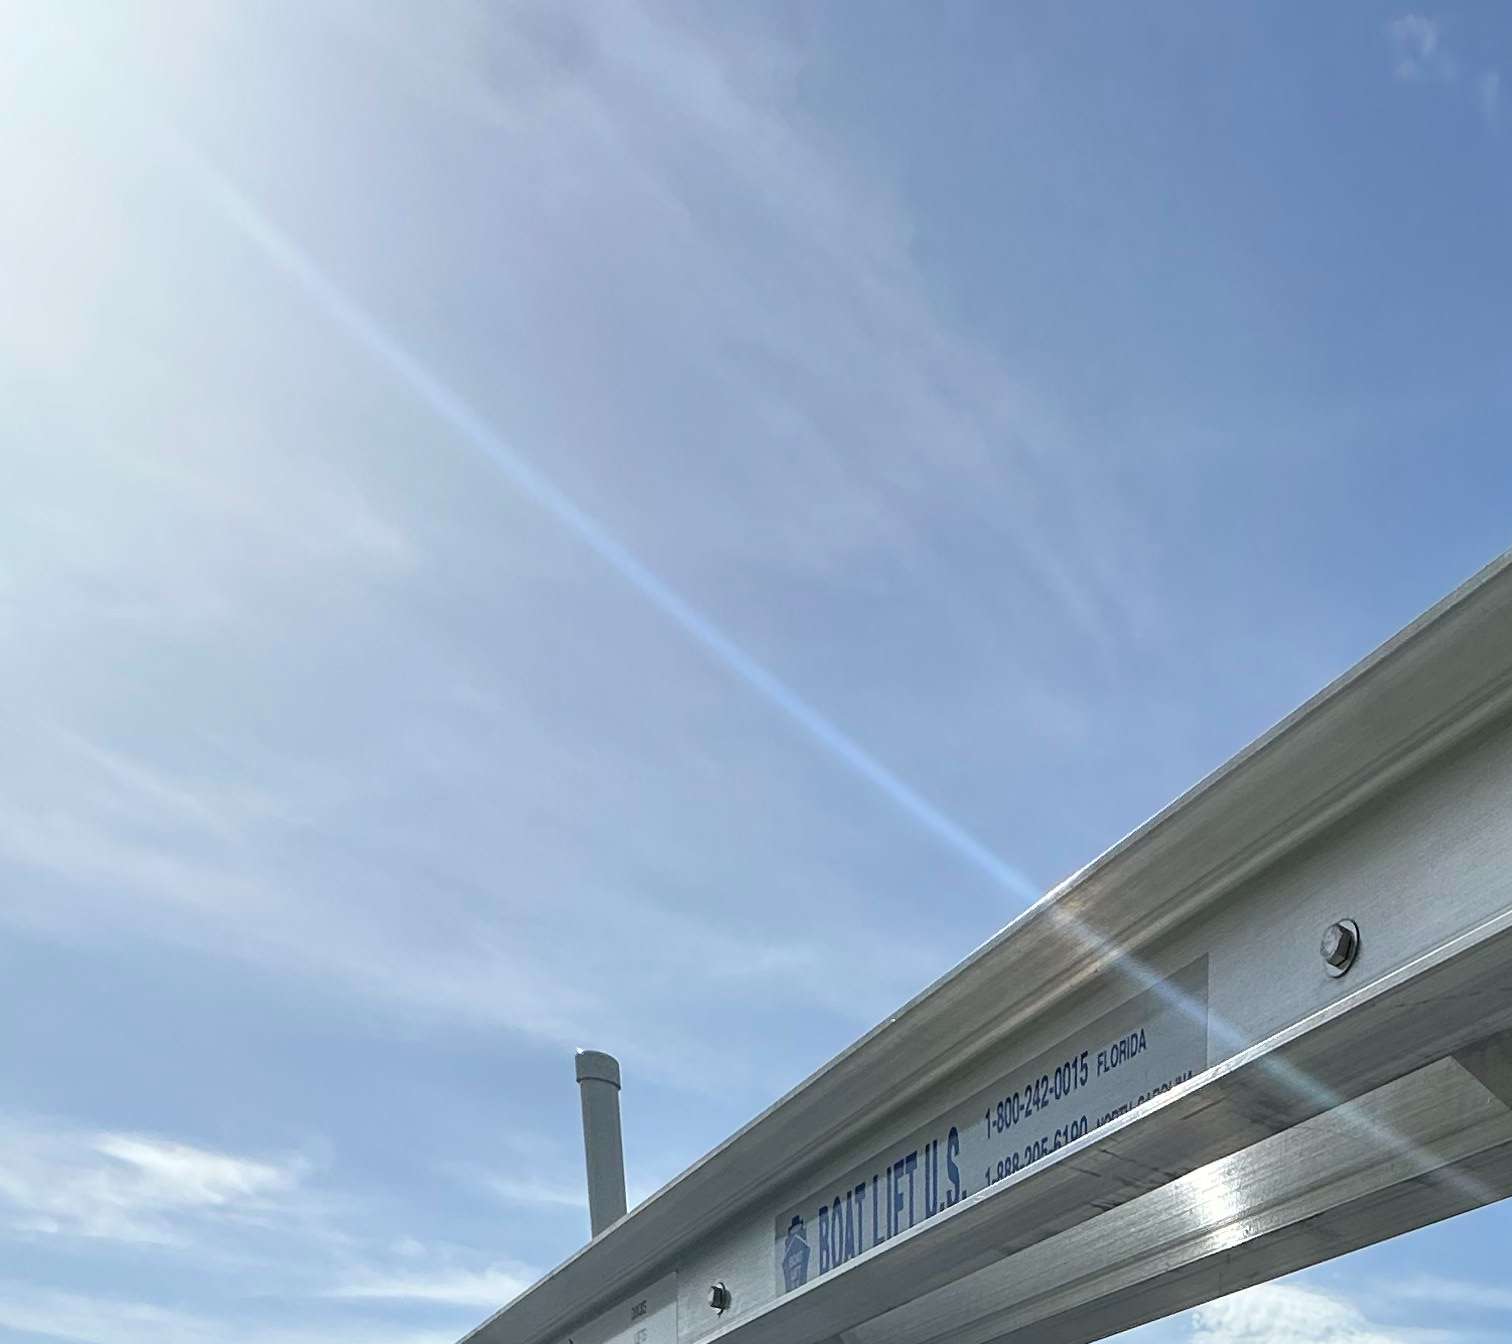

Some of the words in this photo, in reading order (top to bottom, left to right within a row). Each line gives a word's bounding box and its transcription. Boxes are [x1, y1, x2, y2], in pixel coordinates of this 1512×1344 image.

[984, 1051, 1089, 1139] 1-800-242-0015
[1097, 1028, 1147, 1077] FLORIDA
[818, 1182, 866, 1275] BOAT
[873, 1150, 918, 1247] LIFT
